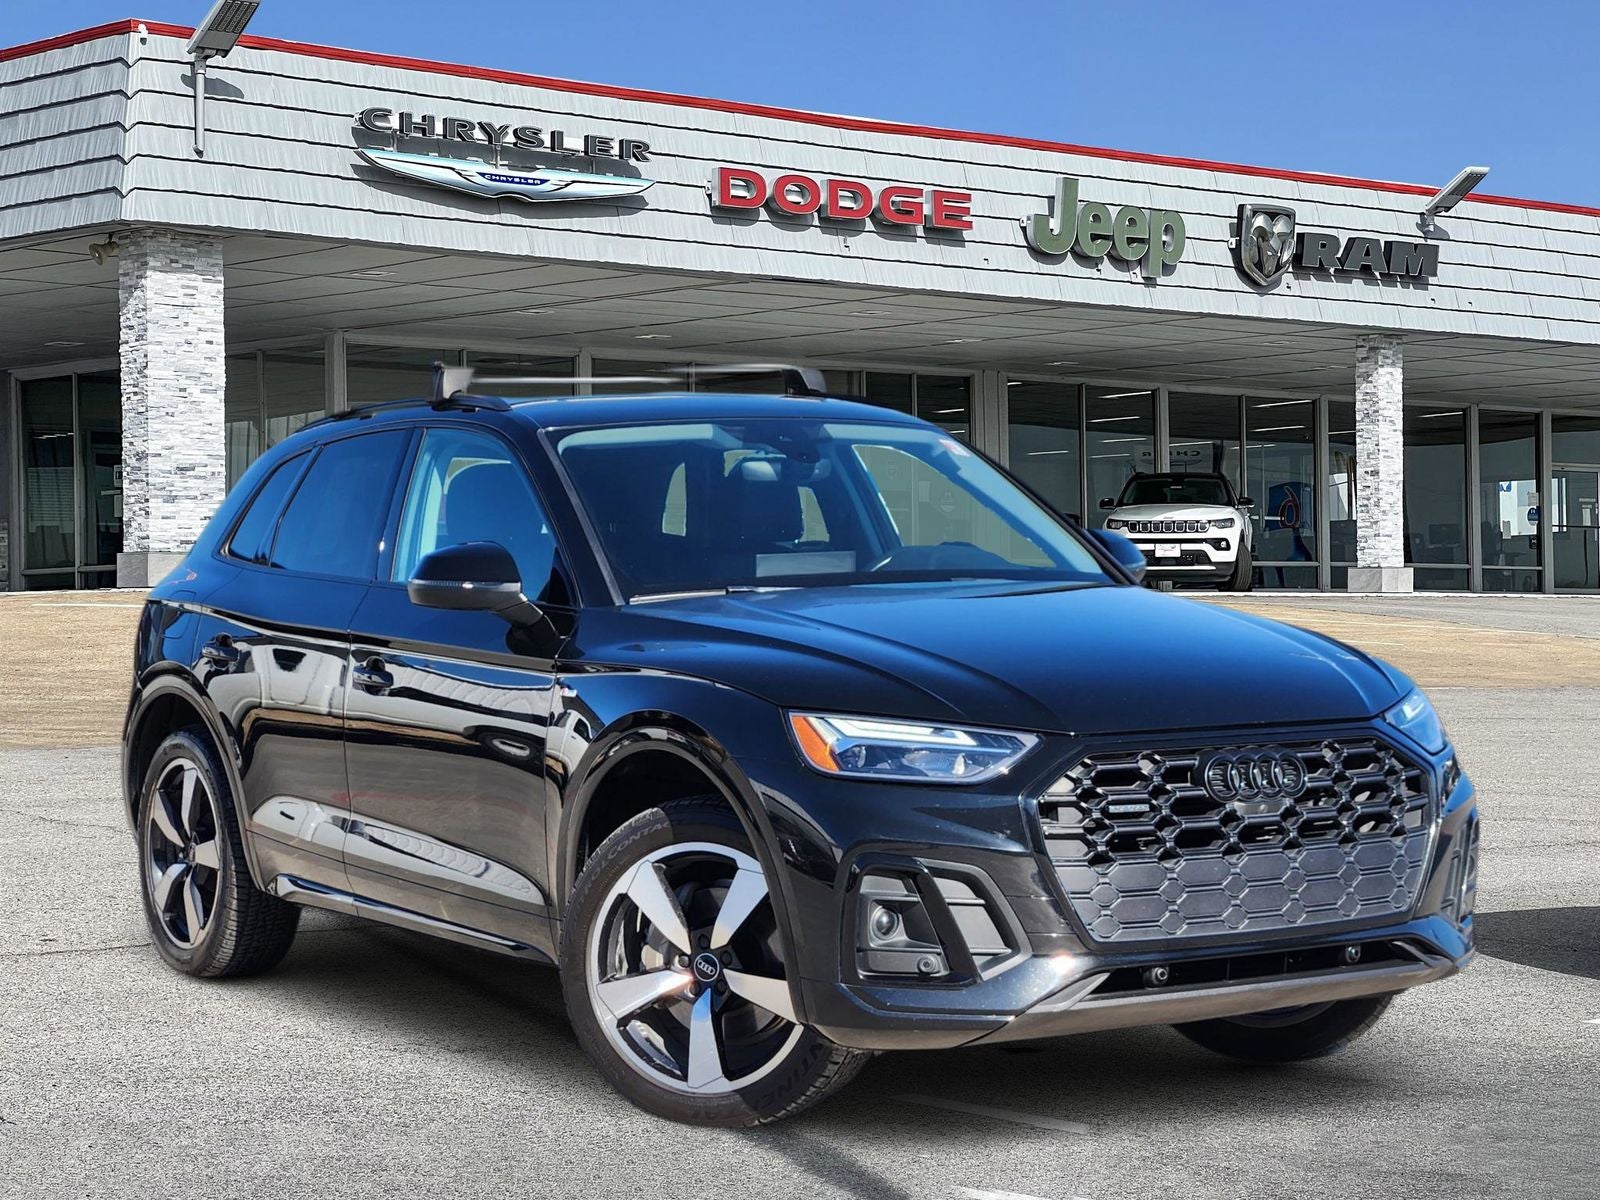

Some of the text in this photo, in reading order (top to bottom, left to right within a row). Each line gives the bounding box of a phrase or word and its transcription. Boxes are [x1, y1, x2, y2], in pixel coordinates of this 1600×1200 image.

[357, 107, 651, 162] CHRYSLER
[484, 174, 541, 185] CHRYSLER
[712, 167, 974, 231] DODGE
[1027, 177, 1186, 278] Jeep
[1296, 232, 1439, 277] RAM
